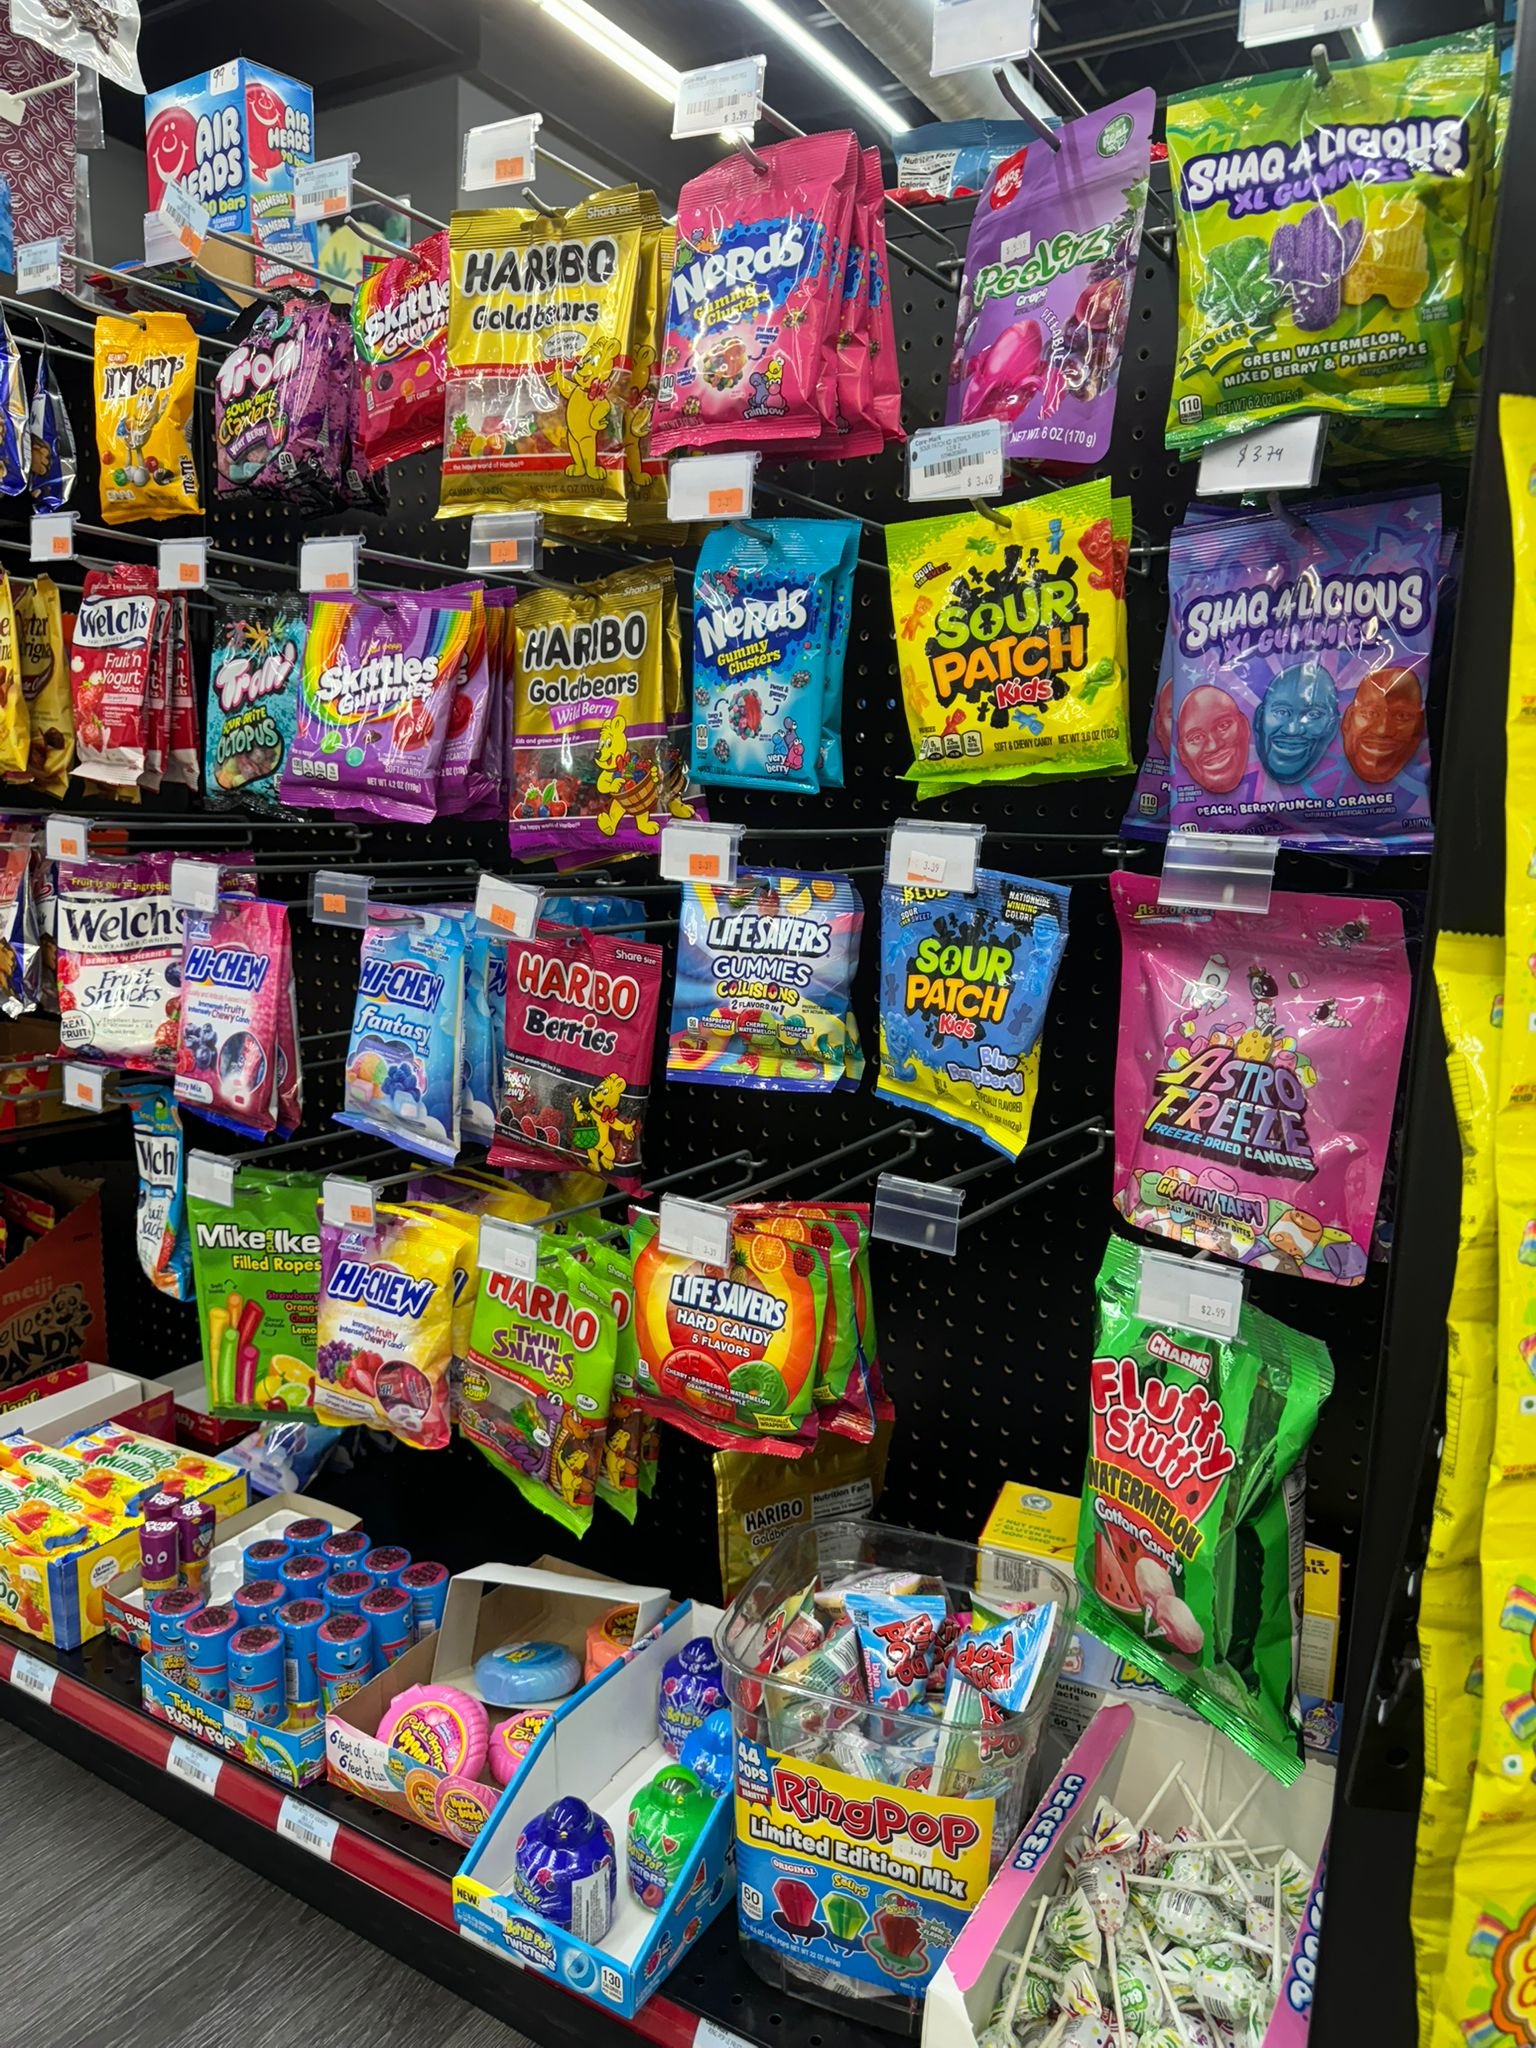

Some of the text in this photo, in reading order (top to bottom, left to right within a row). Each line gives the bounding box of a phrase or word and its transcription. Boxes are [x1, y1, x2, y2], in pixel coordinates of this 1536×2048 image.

[284, 105, 311, 134] AIR
[195, 106, 241, 165] AIR
[267, 128, 311, 154] HEADS
[219, 193, 248, 214] bars
[586, 205, 617, 219] Share
[1234, 187, 1268, 216] XL
[464, 238, 617, 296] HARIBO
[705, 291, 772, 326] Clusters
[1016, 287, 1049, 307] Grape
[472, 302, 599, 331] Goldbears
[1242, 332, 1405, 369] GREEN WATERMELON,
[1223, 342, 1428, 388] MIXED BERRY & PINEAPPLE
[225, 400, 252, 416] SOUR
[743, 403, 786, 421] rainbow
[1180, 396, 1201, 413] 110
[246, 426, 269, 444] BERRY
[1010, 428, 1097, 448] NET 6 OZ (170 g)
[280, 453, 293, 466] 90
[914, 562, 935, 581] SOUR
[623, 585, 648, 598] Share
[79, 601, 150, 638] Welch's
[934, 580, 1077, 649] SOUR
[523, 610, 647, 673] HARIBO
[717, 639, 769, 667] Gummy
[728, 650, 782, 677] Clusters
[931, 624, 1085, 698] PATCH
[102, 670, 141, 688] Yogurt
[317, 653, 442, 701] Skittles
[528, 673, 639, 706] Goldbears
[338, 682, 435, 716] Gummies
[995, 676, 1054, 709] Kids
[554, 701, 615, 729] Wild Berry
[216, 720, 278, 765] OCTOPUS
[696, 724, 708, 738] 100
[994, 742, 1006, 752] SOFT
[1012, 739, 1032, 750] CHEWY
[1032, 737, 1053, 748] CANDY
[1057, 734, 1080, 744] NET WT
[765, 761, 790, 777] berry
[766, 752, 787, 764] very
[1197, 793, 1393, 817] PEACH, BERRY PUNCH & ORANGE
[900, 907, 919, 920] SOUR
[1006, 900, 1038, 914] WINNING
[708, 915, 832, 958] LIFE SAVERS
[129, 949, 168, 962] CHERRIES
[184, 945, 271, 992] HI-CHEW
[615, 949, 642, 962] Share
[916, 937, 1014, 981] SOUR
[712, 957, 813, 988] GUMMIES
[716, 980, 799, 1007] COLLISIONS
[731, 999, 771, 1011] 2 FLAVORS
[906, 973, 1011, 1021] PATCH
[223, 1003, 246, 1016] Fruity
[354, 1005, 432, 1047] fantasy
[524, 1006, 617, 1056] Berries
[738, 1026, 777, 1036] WATERMELON
[745, 1021, 768, 1029] CHERRY
[780, 1024, 814, 1034] PINEAPPLE
[937, 1014, 977, 1040] Kids
[979, 1045, 1019, 1072] Blue
[945, 1062, 1024, 1095] Raspberry
[1155, 1047, 1305, 1111] ASTRO
[1145, 1083, 1313, 1157] FREEZE
[1150, 1122, 1316, 1172] FREEZE-DRIED CANDIES
[1156, 1178, 1263, 1220] GRAVITY TAFFY
[1166, 1203, 1209, 1220] SALT WATER
[196, 1223, 321, 1253] Mike Ike
[232, 1255, 270, 1271] Filled
[607, 1263, 628, 1280] Share
[327, 1259, 438, 1320] HI-CHEW
[579, 1282, 598, 1299] Share
[670, 1274, 788, 1329] LIFE SAVERS
[1200, 1303, 1227, 1321] $2.99
[374, 1325, 398, 1344] Fruity
[511, 1322, 561, 1355] TWIN
[676, 1309, 773, 1347] HARD CANDY
[491, 1329, 575, 1388] SNAKES
[691, 1333, 751, 1358] 5 FLAVORS
[1149, 1332, 1211, 1375] CHARMS
[665, 1367, 771, 1407] CHERRY RASPBERRY WATERMELON
[22, 1451, 83, 1483] Mamba
[94, 1454, 155, 1482] Mamba
[118, 1442, 176, 1468] Mamba
[813, 1481, 870, 1503] Nutrition Facts
[744, 1498, 804, 1533] HARIBO
[1093, 1497, 1185, 1578] Cotton Candy
[164, 1704, 205, 1738] PUSH
[205, 1723, 236, 1751] POP
[329, 1729, 340, 1745] 6
[338, 1754, 350, 1769] 6
[738, 1742, 761, 1767] 44
[738, 1762, 770, 1783] POPS
[1012, 1774, 1086, 1872] CHARMS
[644, 1852, 665, 1871] Pop
[750, 1814, 968, 1901] Limited Edition Mix
[772, 1859, 817, 1876] ORIGINAL
[456, 1887, 481, 1908] NEW!
[742, 1886, 761, 1906] 60
[502, 1932, 557, 1973] TWISTERS
[533, 1933, 554, 1952] Pop
[603, 1968, 622, 1989] 130
